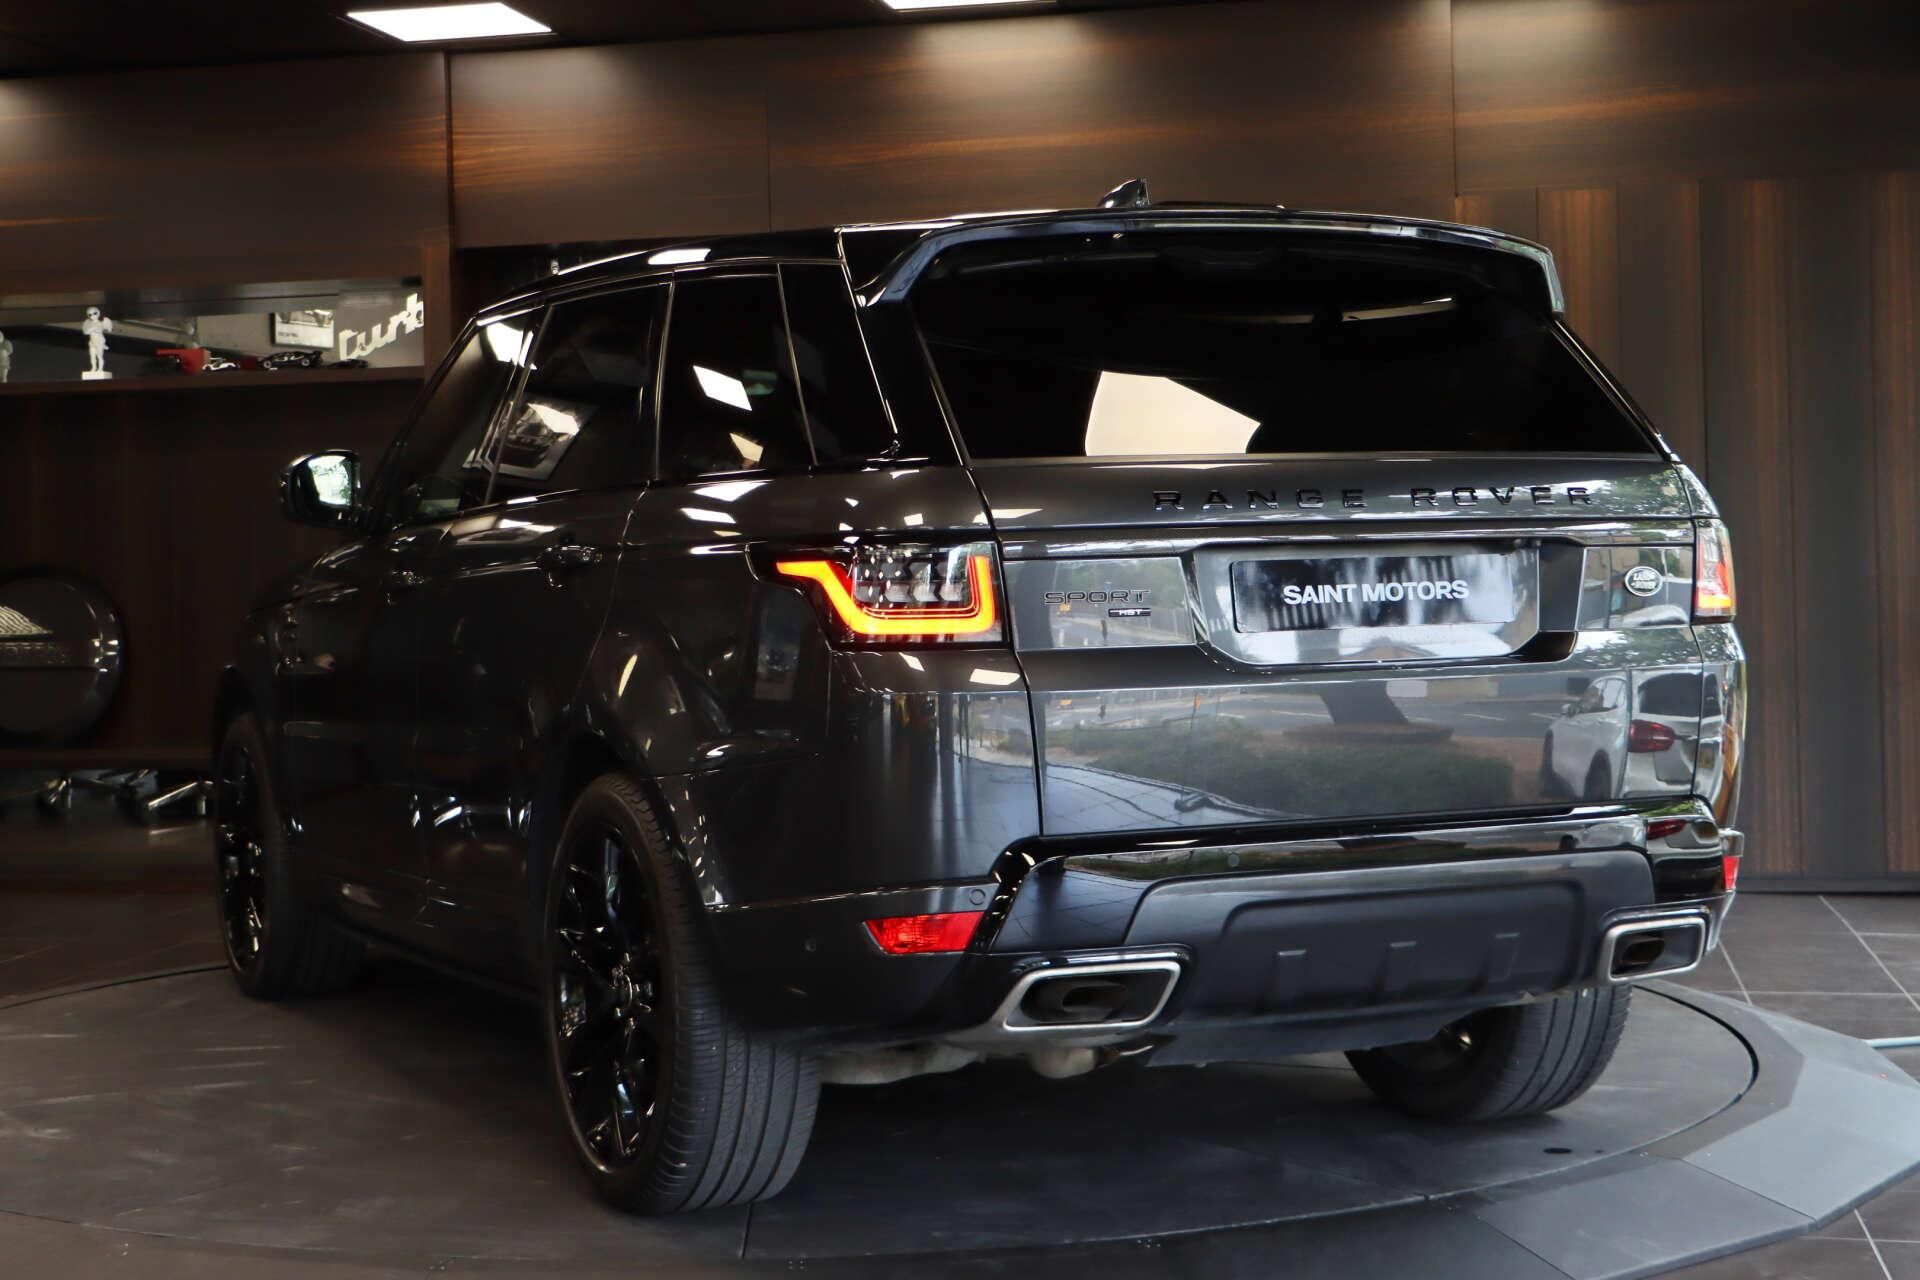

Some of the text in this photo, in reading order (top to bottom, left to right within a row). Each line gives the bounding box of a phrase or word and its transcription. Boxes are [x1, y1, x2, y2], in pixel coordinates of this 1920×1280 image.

[1153, 486, 1593, 511] RANGE ROVER
[1044, 589, 1150, 605] SPORT
[1283, 580, 1471, 605] SAINT MOTORS
